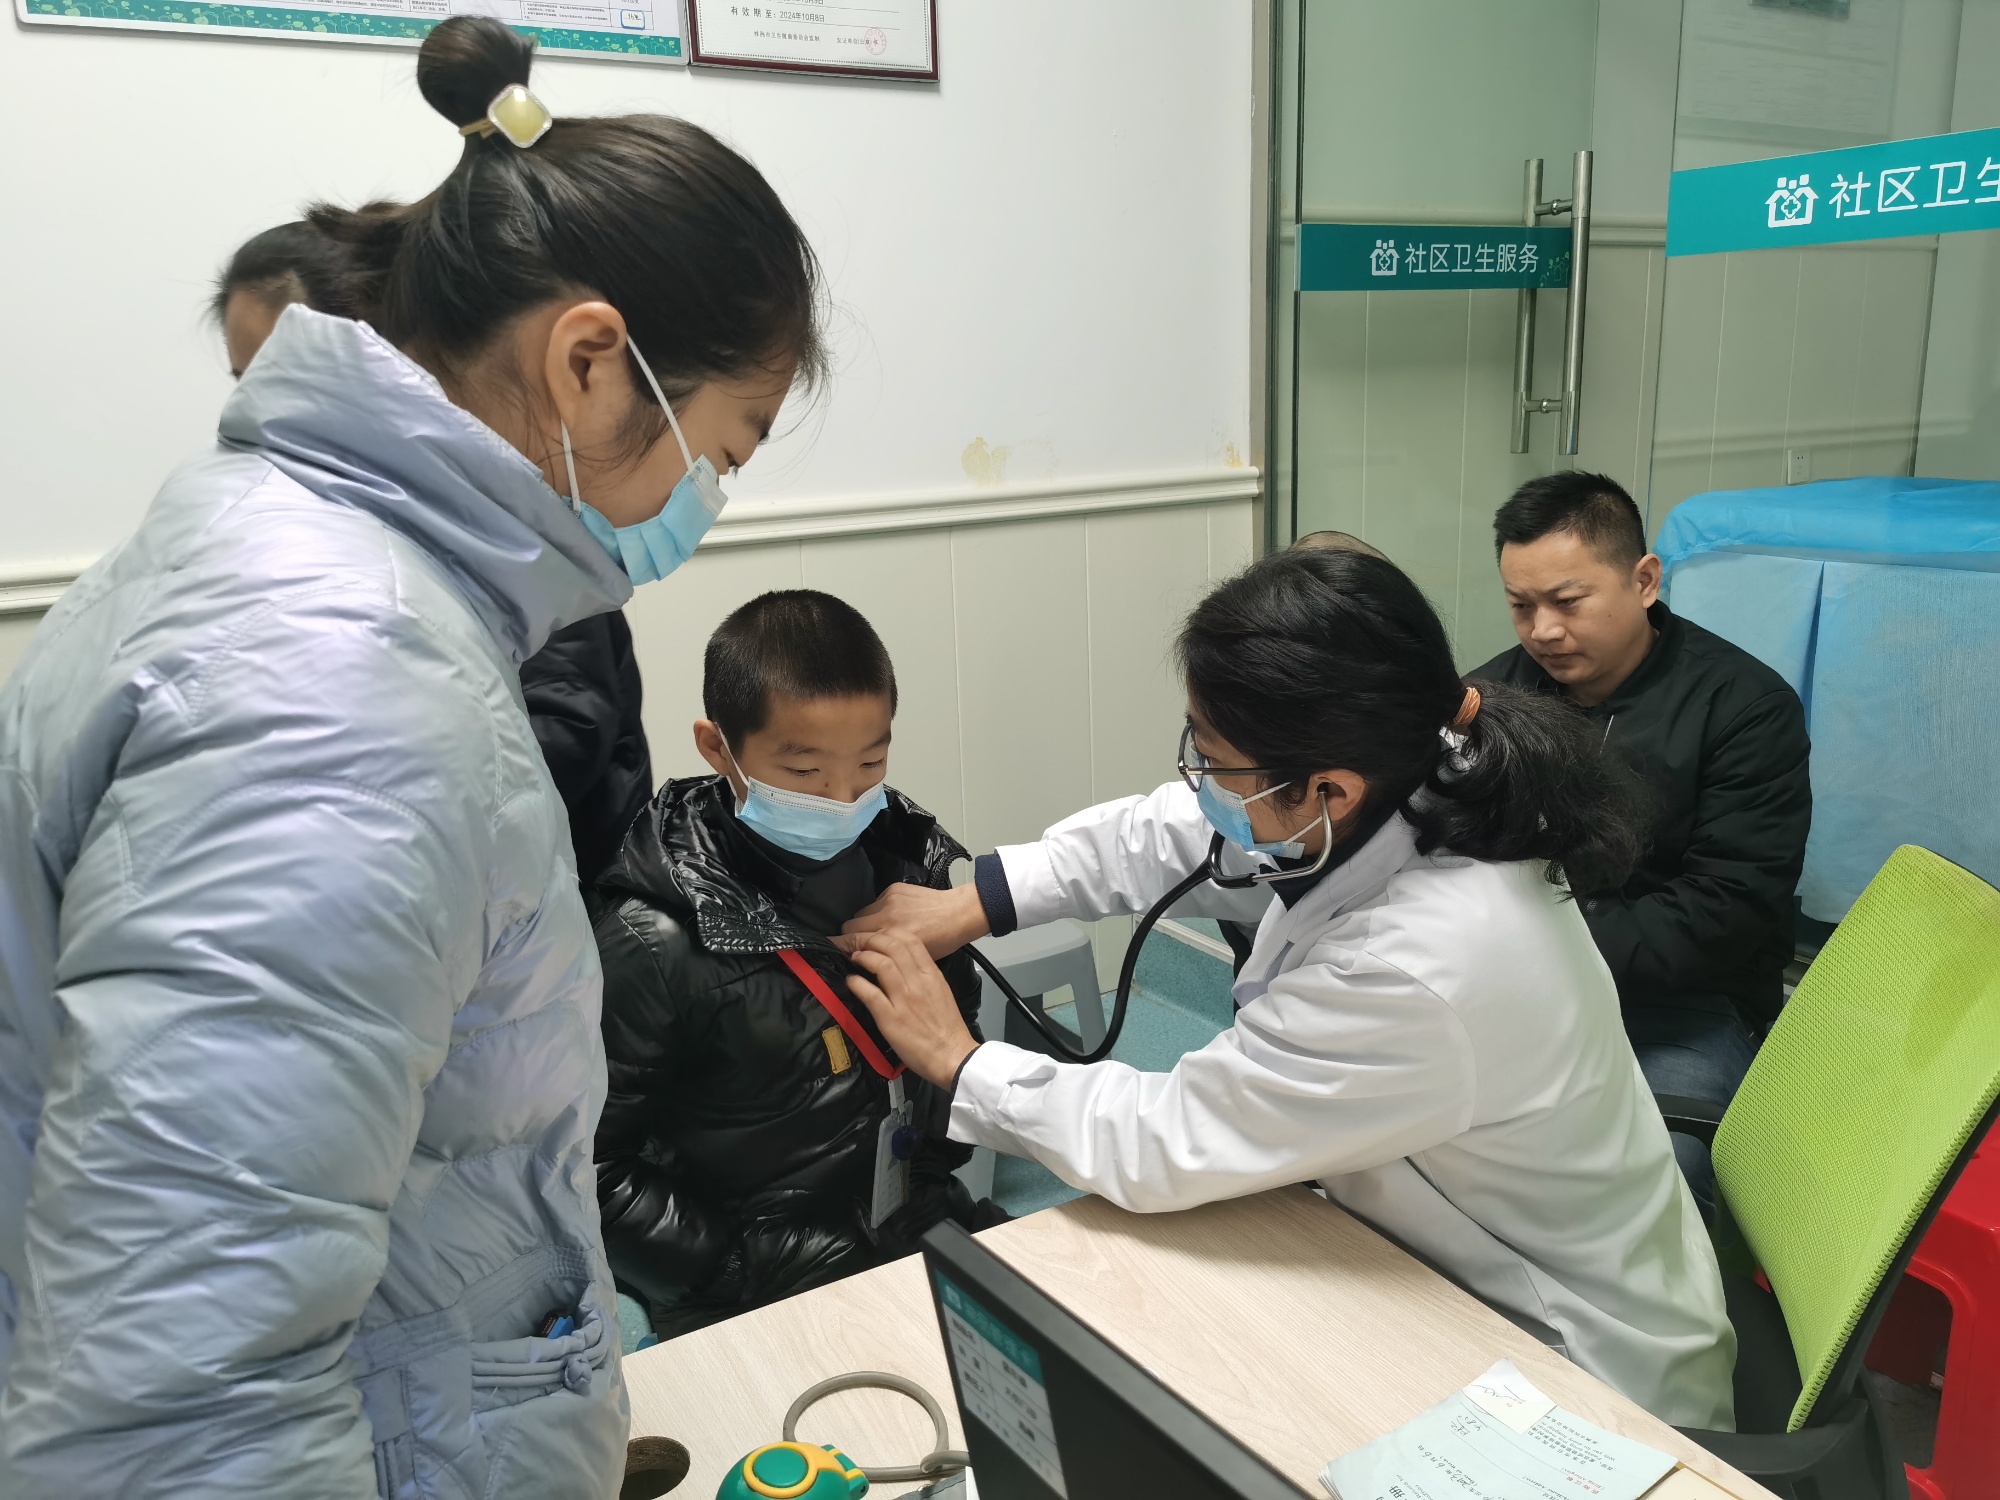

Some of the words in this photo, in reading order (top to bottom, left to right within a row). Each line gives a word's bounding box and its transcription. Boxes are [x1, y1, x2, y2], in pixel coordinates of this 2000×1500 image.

[1404, 242, 1539, 274] 社区卫生服务
